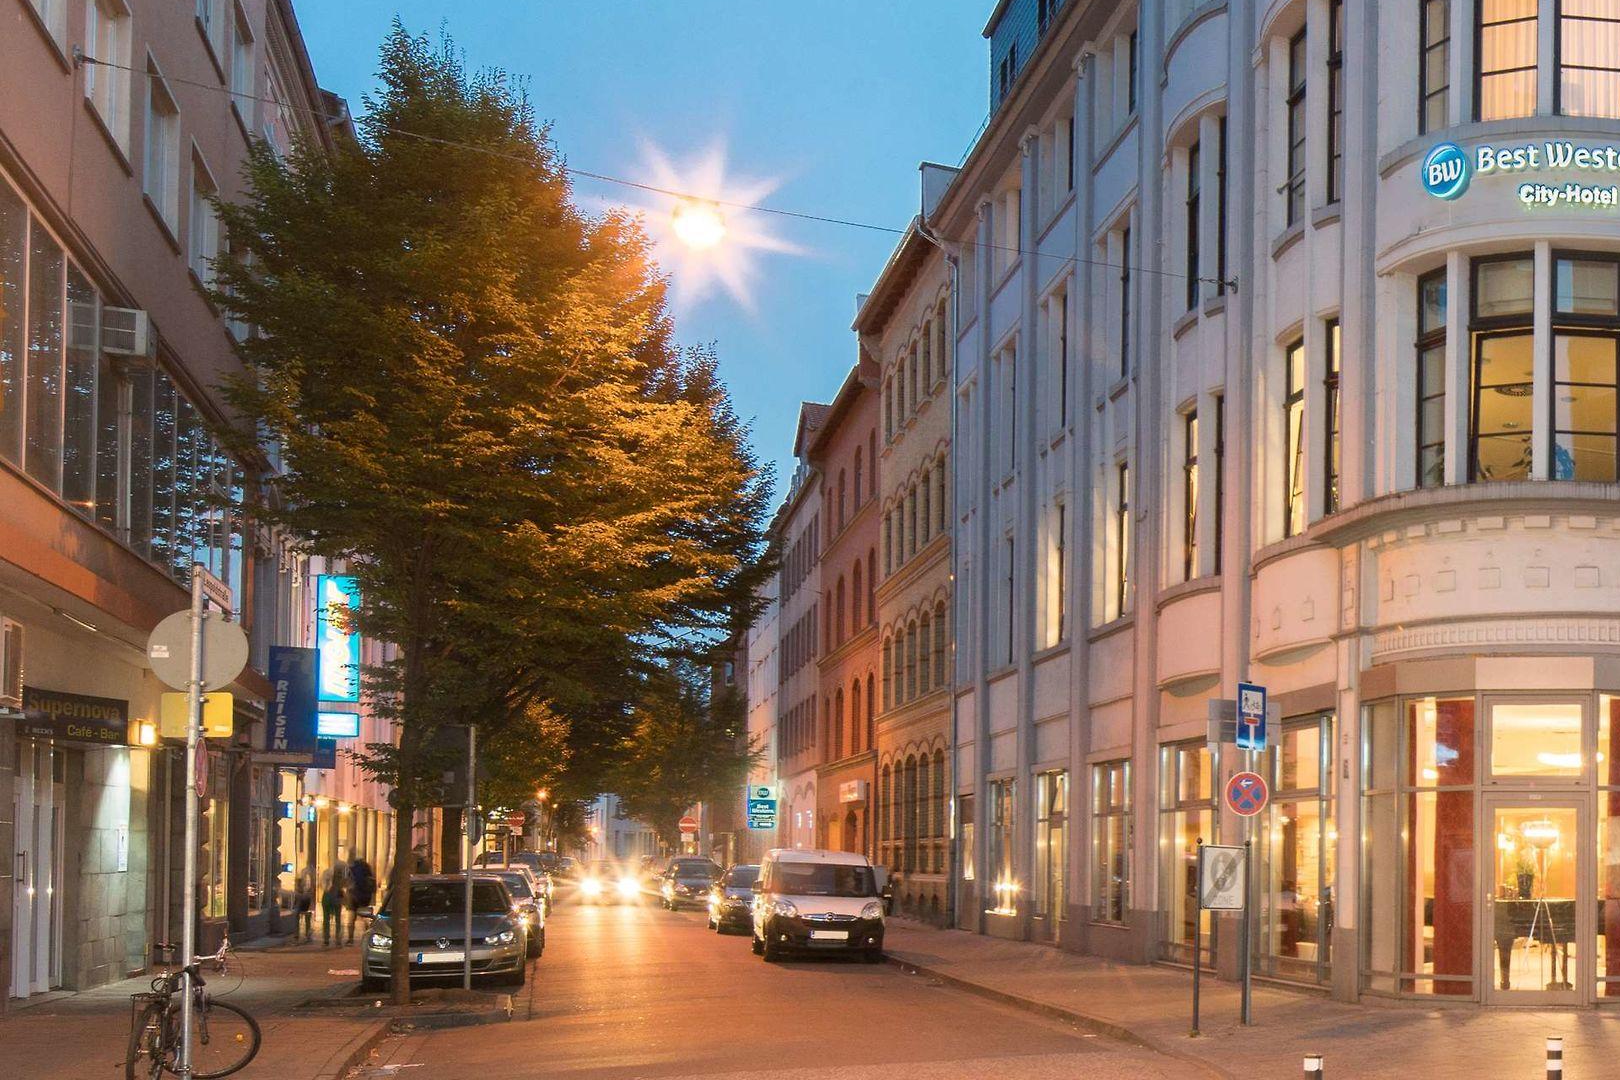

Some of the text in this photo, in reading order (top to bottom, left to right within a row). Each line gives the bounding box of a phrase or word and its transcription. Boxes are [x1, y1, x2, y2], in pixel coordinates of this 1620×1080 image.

[1428, 158, 1461, 186] BW
[1477, 145, 1539, 172] Best
[1519, 184, 1618, 206] City-Hotel
[29, 693, 120, 722] Supernova
[274, 679, 290, 750] REISEN
[100, 728, 119, 740] Bar
